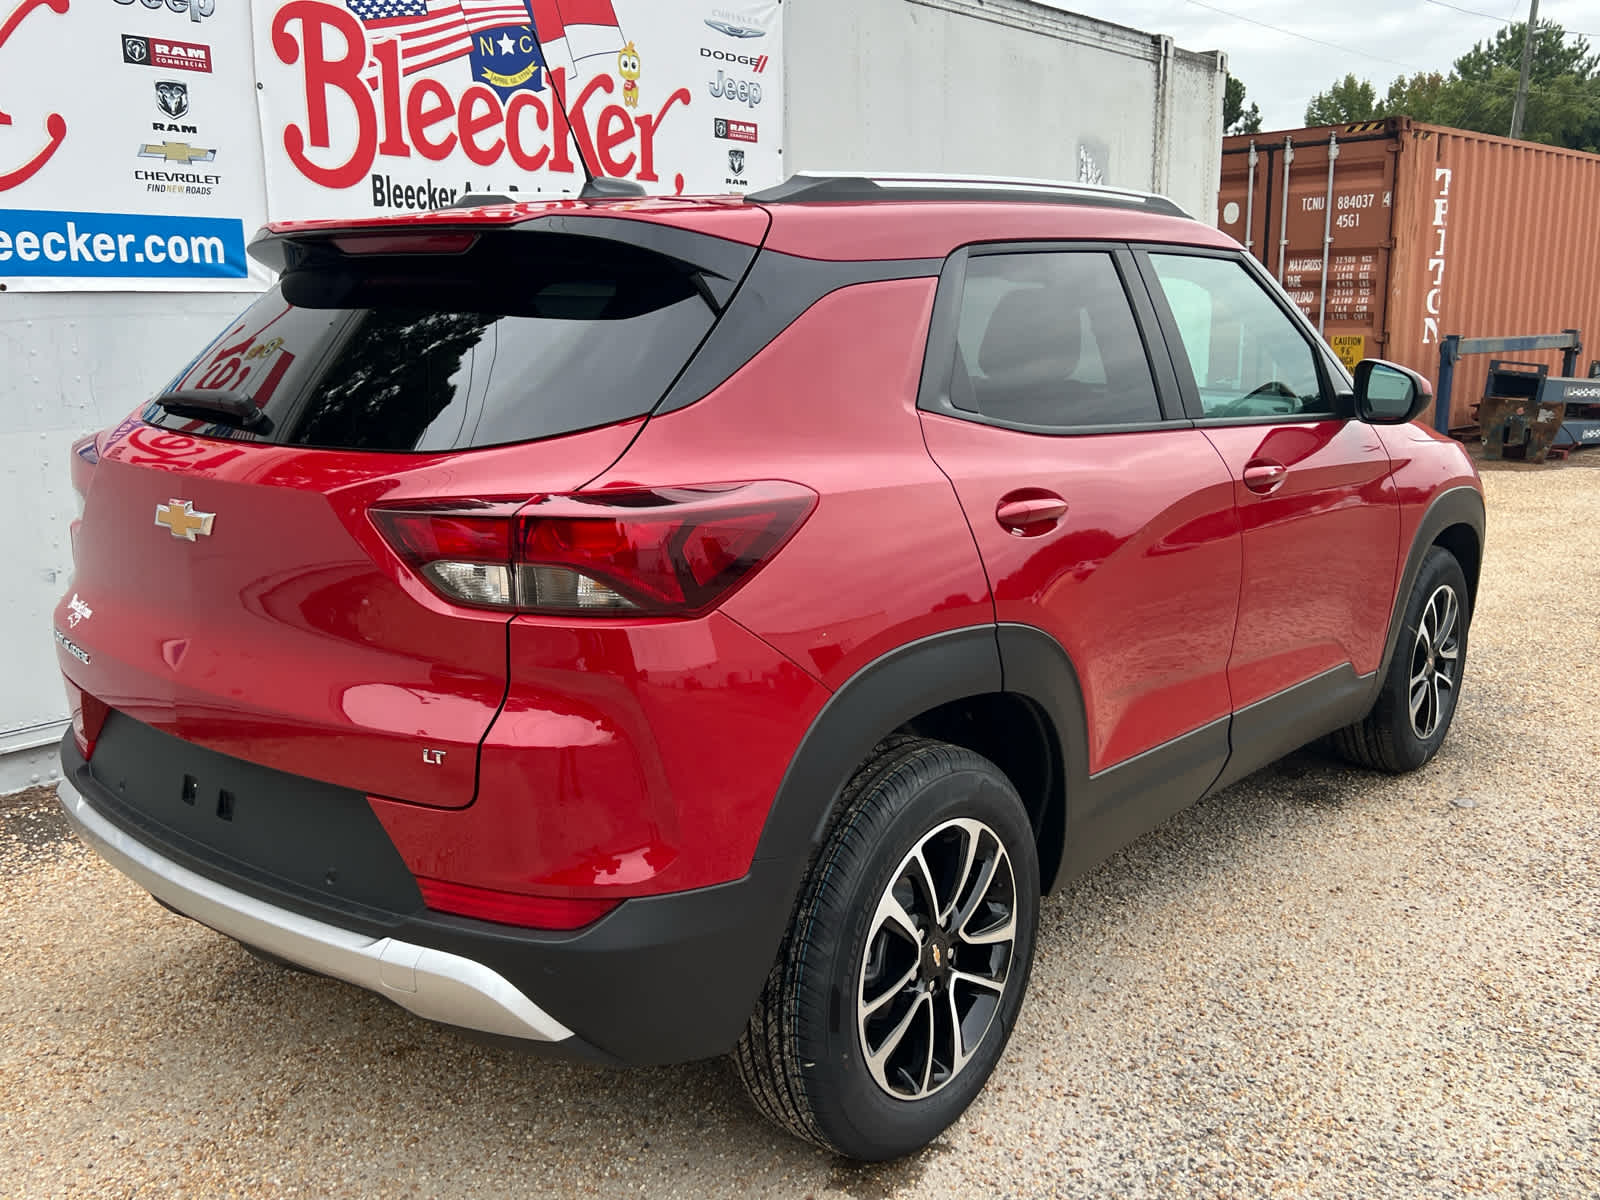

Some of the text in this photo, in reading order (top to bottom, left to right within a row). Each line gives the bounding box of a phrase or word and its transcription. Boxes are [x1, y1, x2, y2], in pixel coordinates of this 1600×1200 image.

[154, 43, 206, 59] RAM
[479, 35, 533, 57] N C
[156, 57, 207, 69] COMMERCIAL
[700, 48, 760, 67] DODGE
[709, 69, 762, 108] Jeep
[152, 122, 197, 134] RAM
[730, 123, 756, 133] RAM
[134, 170, 221, 185] CHEVROLET
[725, 177, 748, 186] RAM
[147, 183, 166, 193] FIND
[185, 185, 213, 196] ROADS
[372, 174, 457, 210] Bleecker
[1301, 191, 1391, 211] TCNU 884037 4
[1336, 213, 1360, 228] 45G1
[1334, 336, 1362, 346] CAUTION
[423, 748, 447, 765] LT
